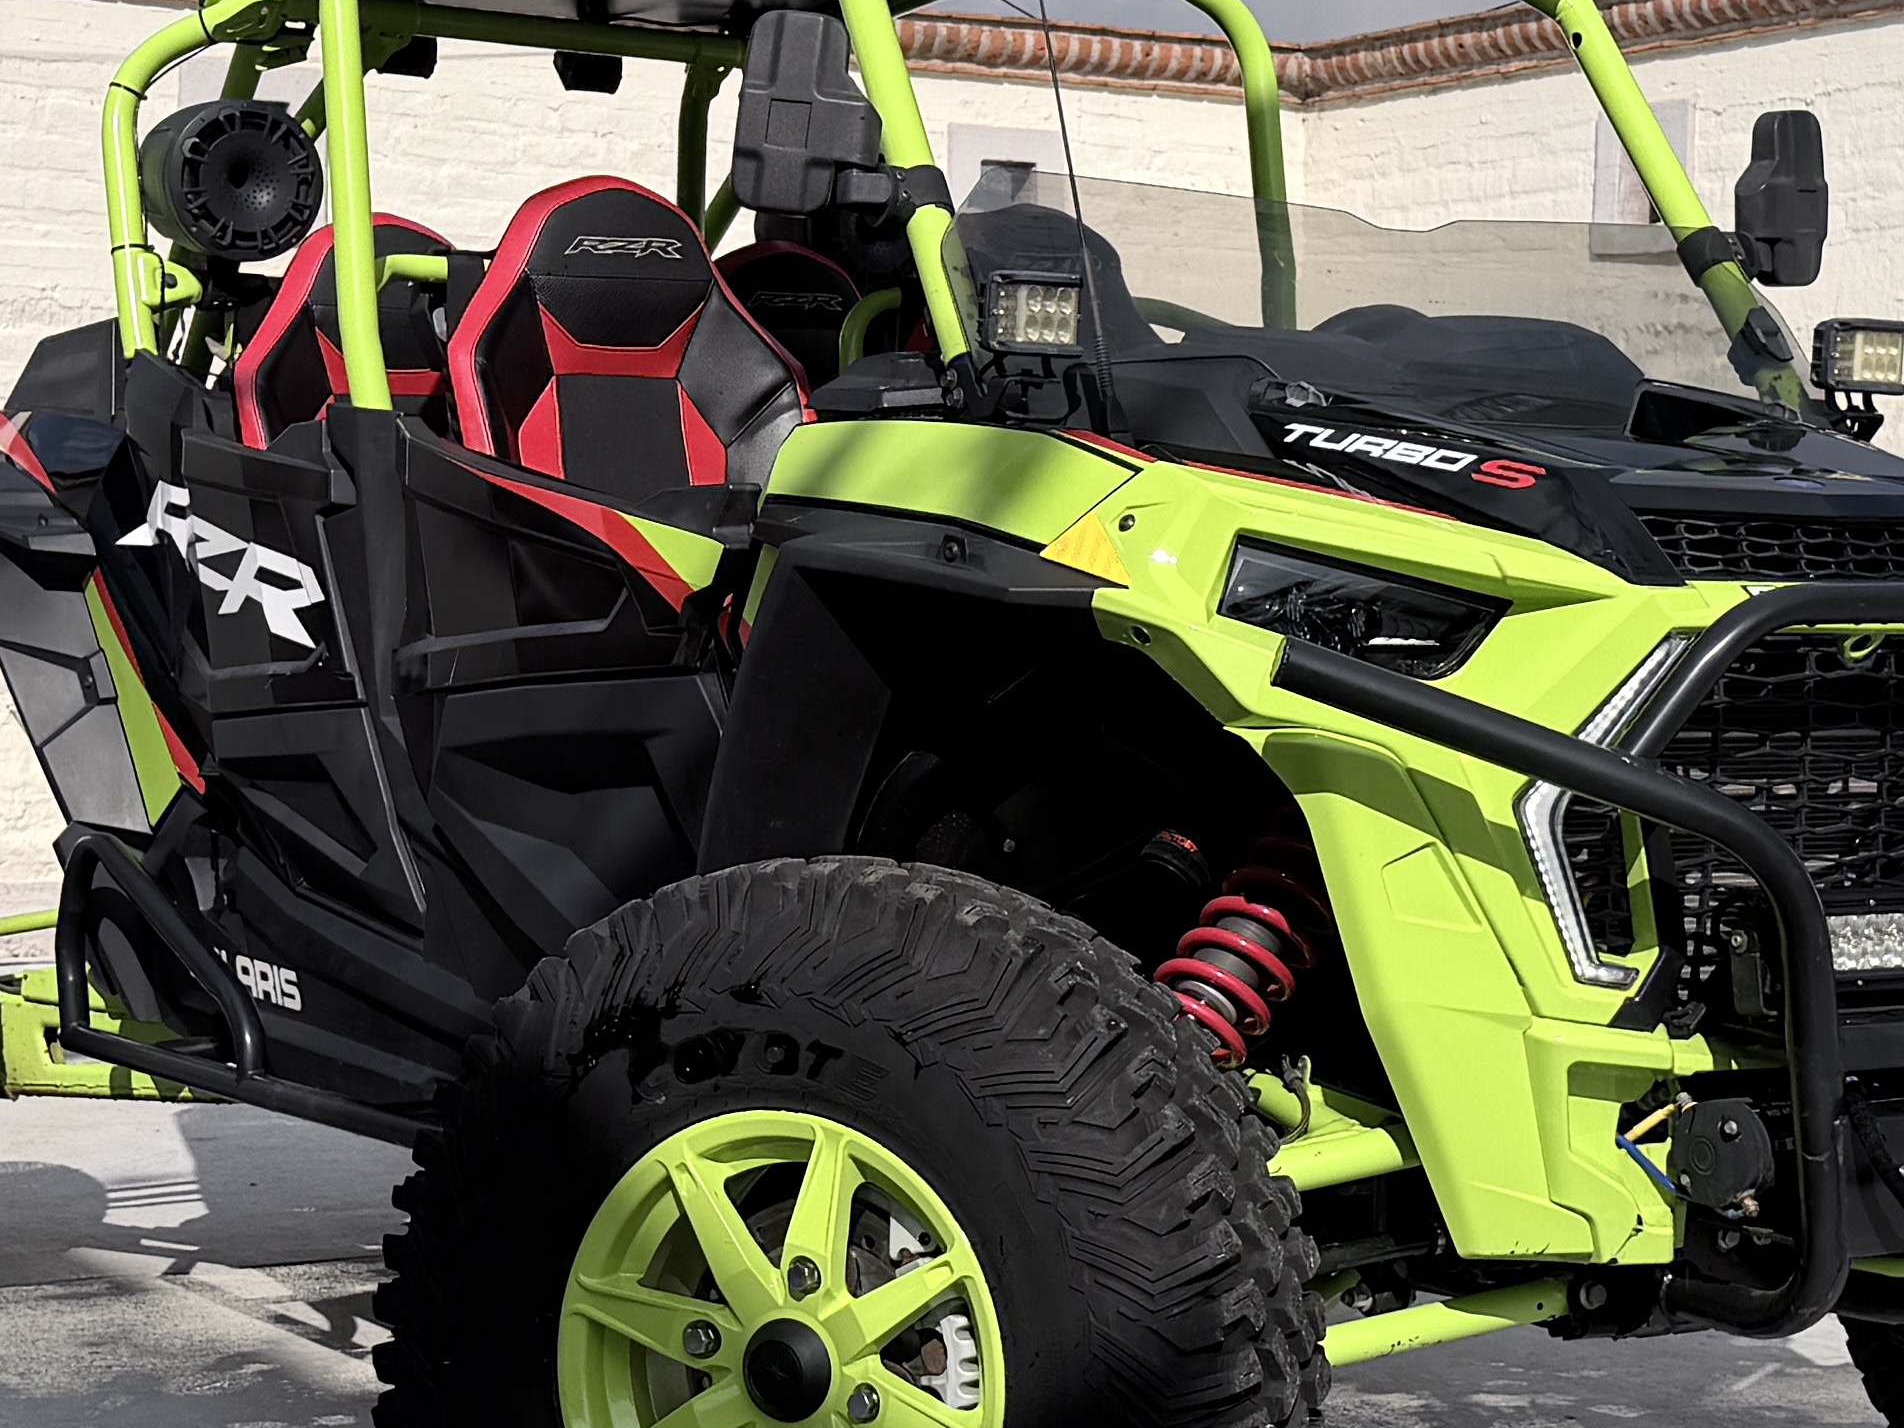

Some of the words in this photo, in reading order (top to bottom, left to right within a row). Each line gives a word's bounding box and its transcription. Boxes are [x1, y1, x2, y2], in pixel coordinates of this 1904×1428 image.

[564, 236, 683, 259] RZR
[747, 291, 843, 310] RZR
[1283, 423, 1479, 472] TURBO
[1471, 459, 1546, 489] S
[115, 480, 325, 649] RZR
[213, 946, 302, 1011] ARIS
